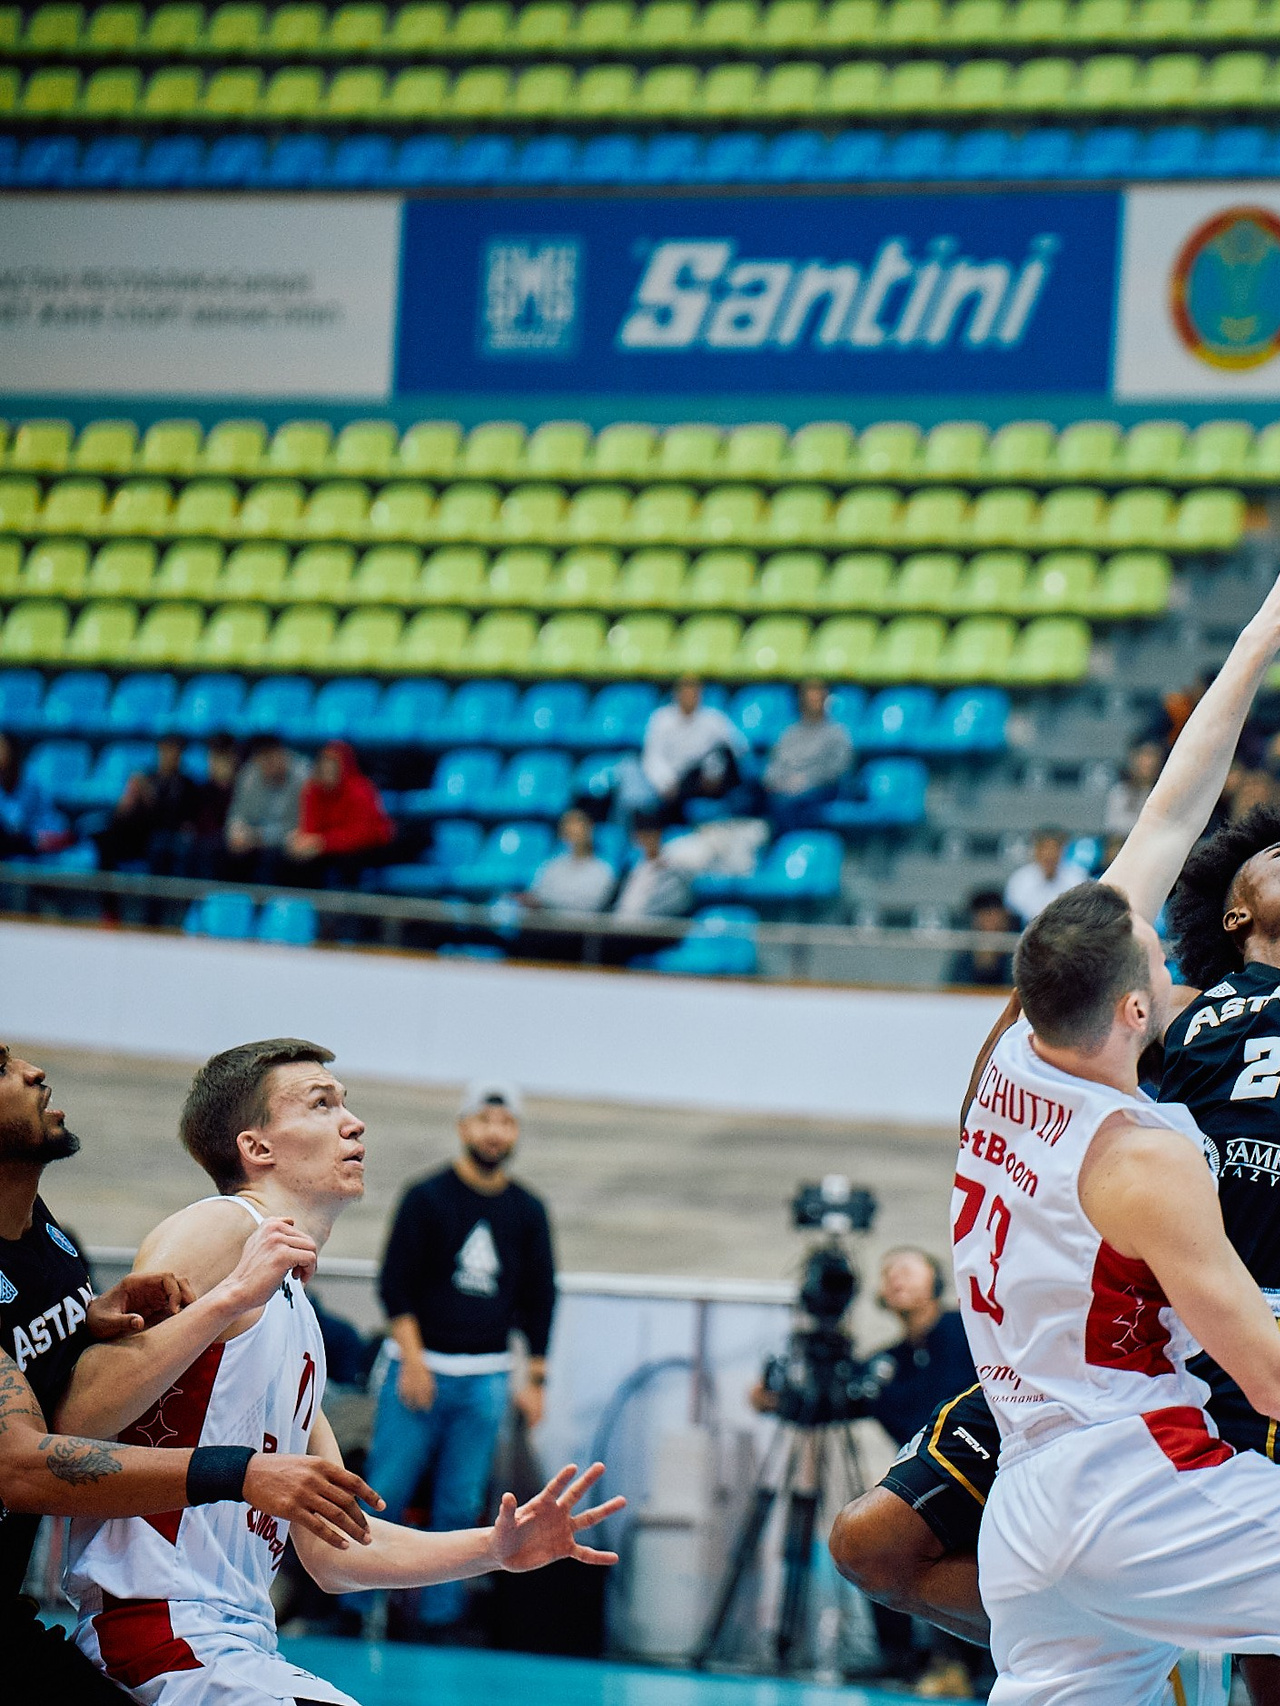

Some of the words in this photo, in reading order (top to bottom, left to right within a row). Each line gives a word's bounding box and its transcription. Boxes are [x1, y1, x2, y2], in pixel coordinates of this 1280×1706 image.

[618, 235, 1059, 347] Santini
[974, 1061, 1072, 1148] CHUTIN
[953, 1172, 1012, 1326] 73
